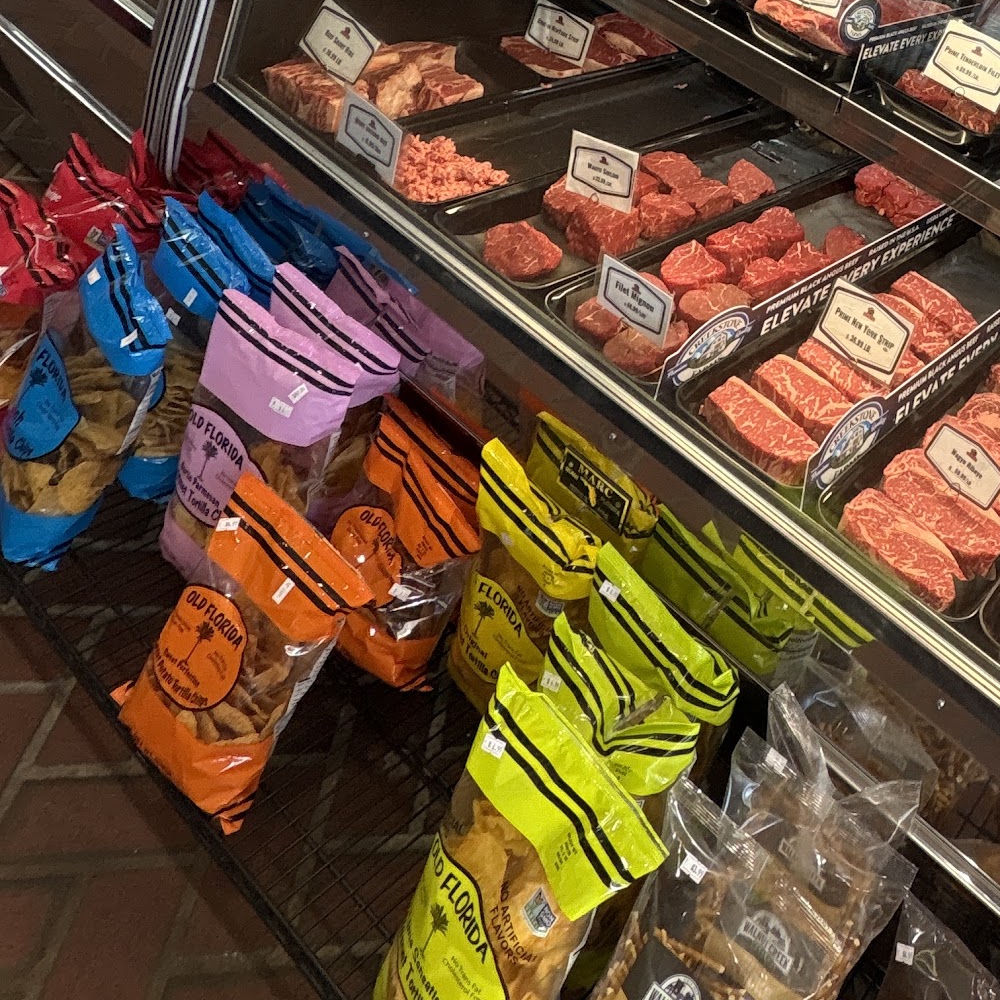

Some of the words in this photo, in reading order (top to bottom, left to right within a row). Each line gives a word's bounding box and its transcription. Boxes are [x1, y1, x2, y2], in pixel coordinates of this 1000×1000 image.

[861, 40, 900, 61] ELEVATE
[899, 33, 927, 50] EVERY
[760, 283, 832, 336] ELEVATE
[843, 255, 883, 284] VERY
[881, 213, 956, 265] EXPERIENCE
[765, 290, 800, 314] PREMIUM
[800, 279, 822, 295] BLACK
[822, 265, 844, 283] ANGUS
[844, 256, 860, 271] BEEF
[868, 240, 889, 256] RAISED
[888, 237, 896, 246] IN
[896, 231, 907, 242] THE
[615, 280, 630, 297] Filet
[630, 289, 655, 313] Mignon
[688, 318, 742, 356] CREEKSTONE
[37, 348, 67, 402] FLORIDA
[897, 375, 927, 403] PREMIUM
[927, 360, 947, 379] BLACK
[947, 346, 966, 366] ANGUS
[964, 334, 980, 351] BEEF
[204, 422, 244, 471] FLORIDA
[829, 409, 877, 453] CREEKSTONE
[578, 463, 613, 499] MARC
[951, 448, 967, 465] Wagyu
[966, 462, 983, 479] Ribeye
[360, 509, 381, 527] OLD
[186, 590, 208, 611] OLD
[204, 603, 243, 651] FLORIDA
[477, 582, 522, 638] FLORIDA
[463, 624, 488, 659] Original
[466, 643, 489, 676] Tortilla
[500, 881, 509, 903] NO
[440, 872, 490, 964] FLORIDA
[490, 905, 520, 965] FLAVORS
[743, 919, 770, 950] WALNUT
[768, 942, 792, 971] CREEK
[450, 955, 459, 967] No
[458, 964, 472, 986] Trans
[471, 982, 482, 995] Fat
